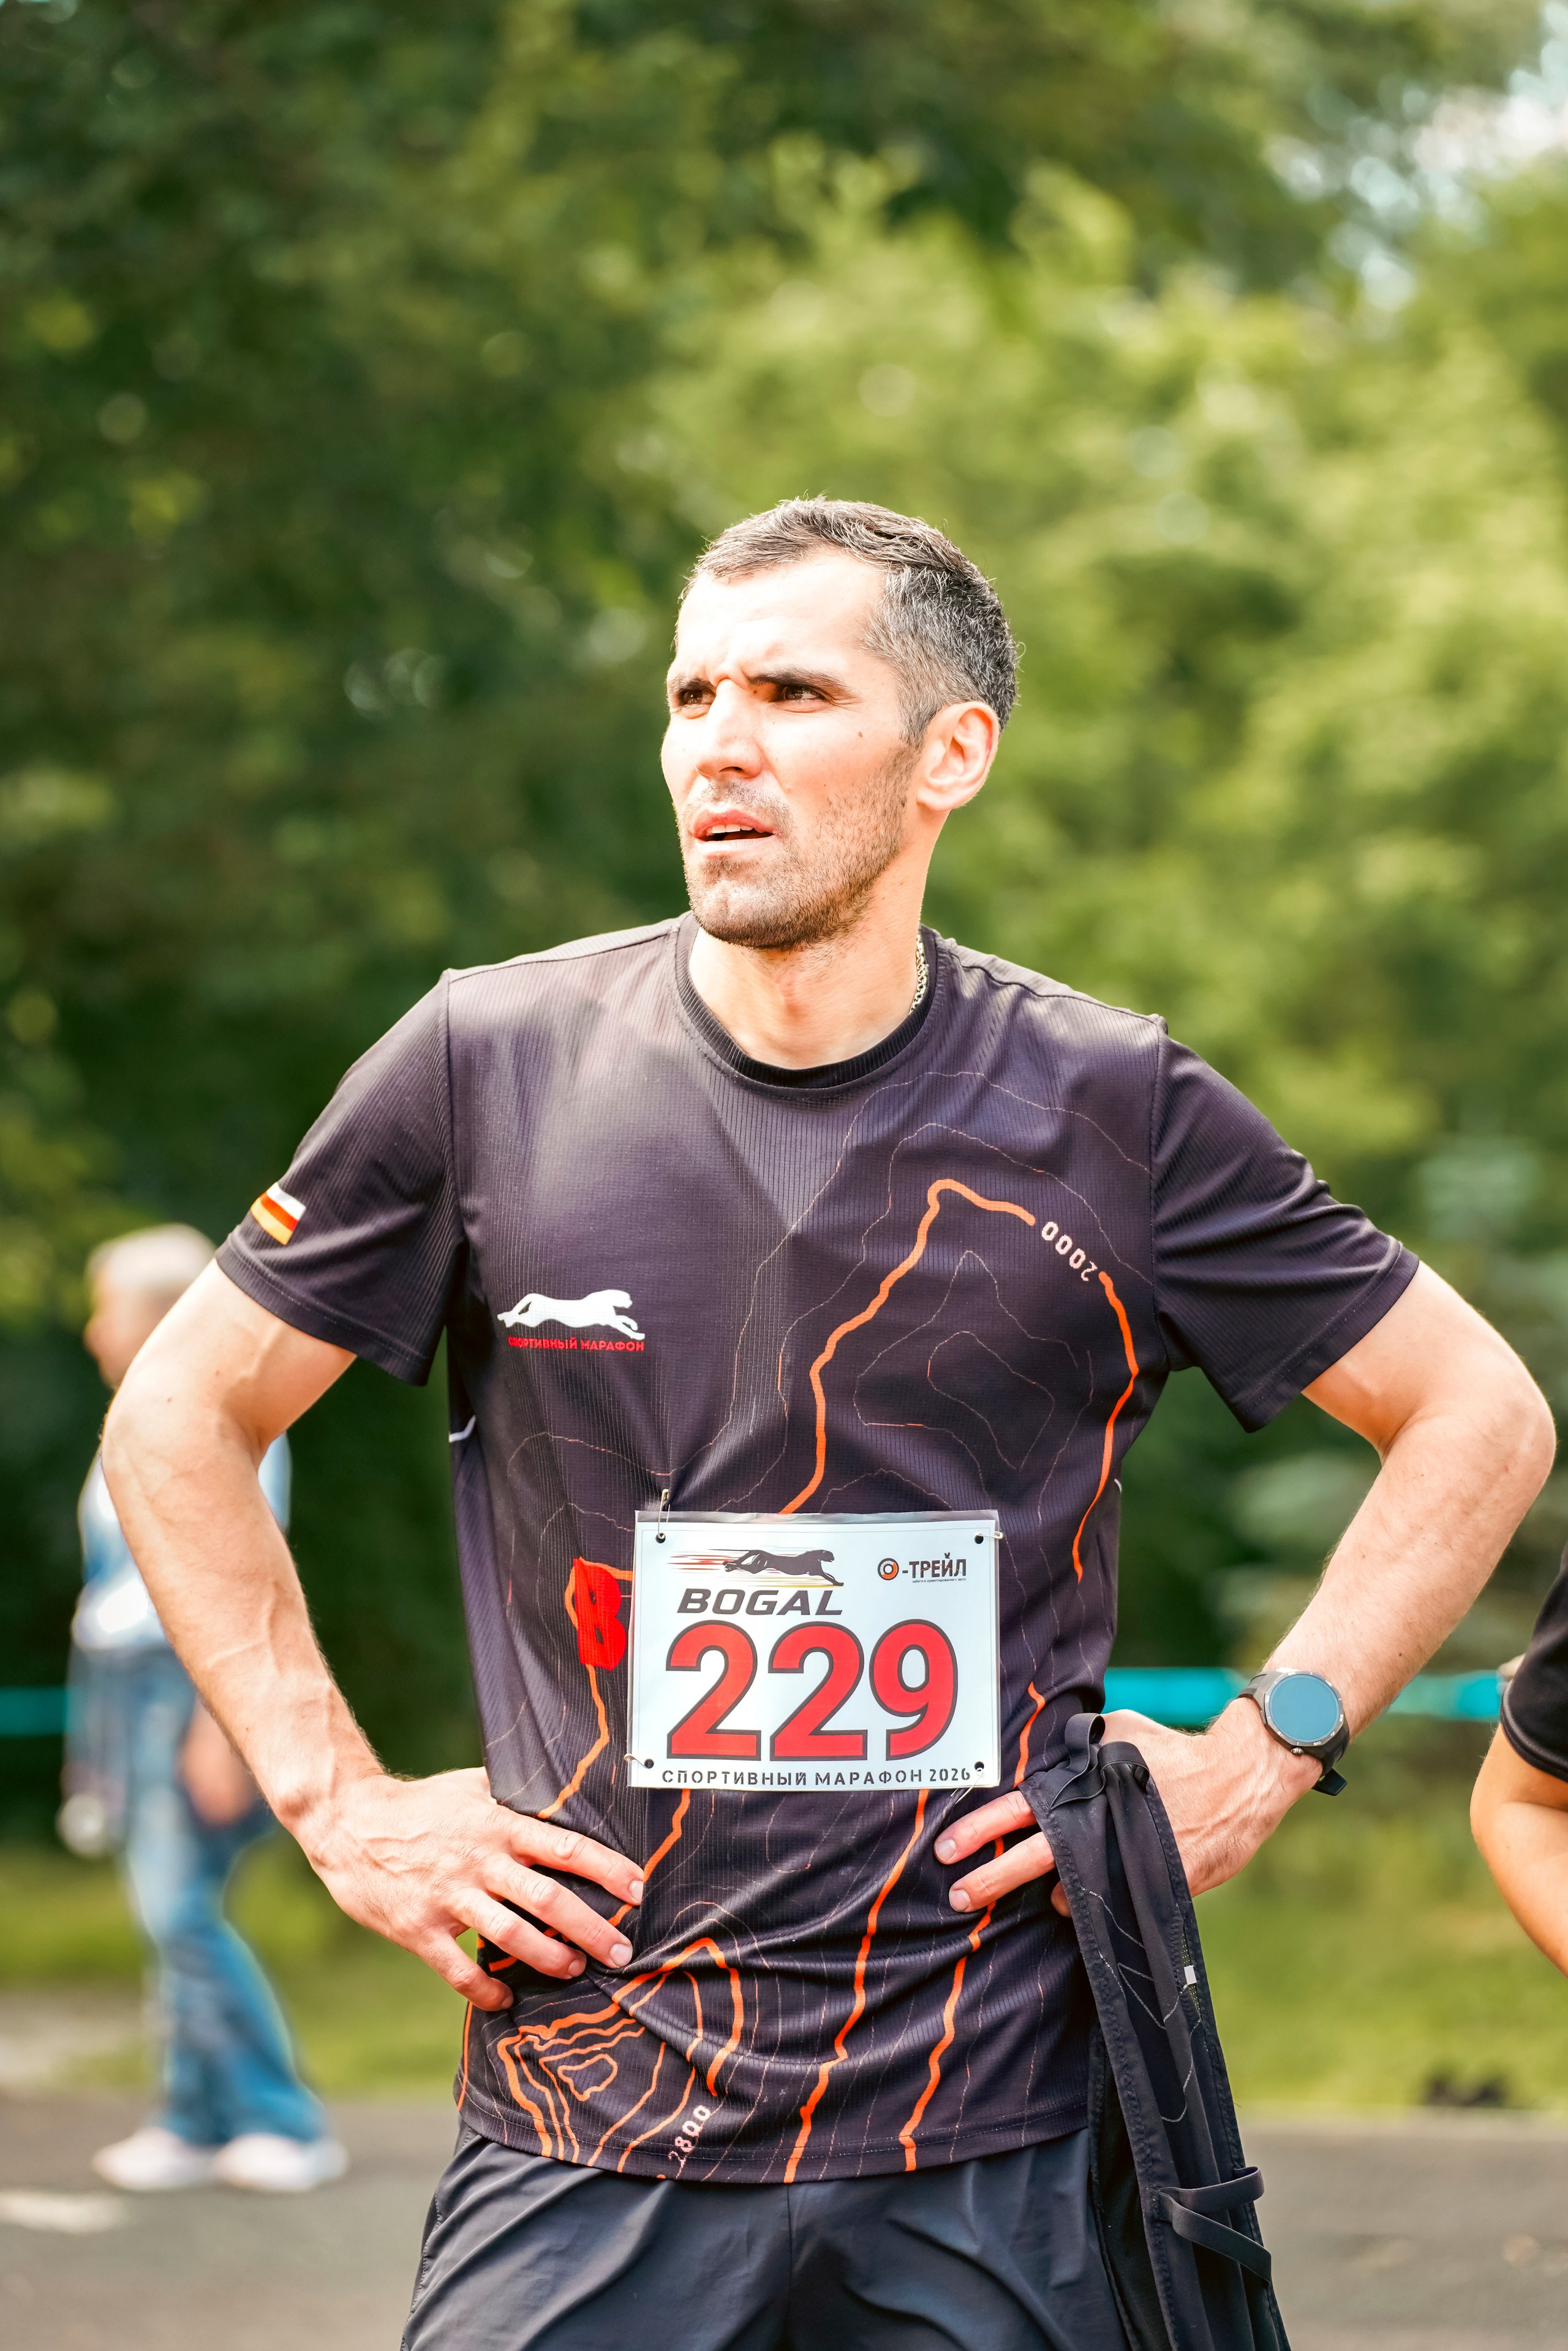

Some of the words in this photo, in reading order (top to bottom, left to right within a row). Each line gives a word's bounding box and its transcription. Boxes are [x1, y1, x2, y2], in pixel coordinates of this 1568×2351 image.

[1041, 1221, 1098, 1281] 2000
[508, 1336, 578, 1349] СПОРТИВНЫЙ
[581, 1339, 644, 1351] МАРАФОН
[677, 1588, 843, 1615] BOGAL
[666, 1618, 958, 1762] 229
[662, 1769, 807, 1786] СПОРТИВНЫЙ
[815, 1769, 922, 1786] МАРАФОН
[929, 1768, 971, 1782] 2026
